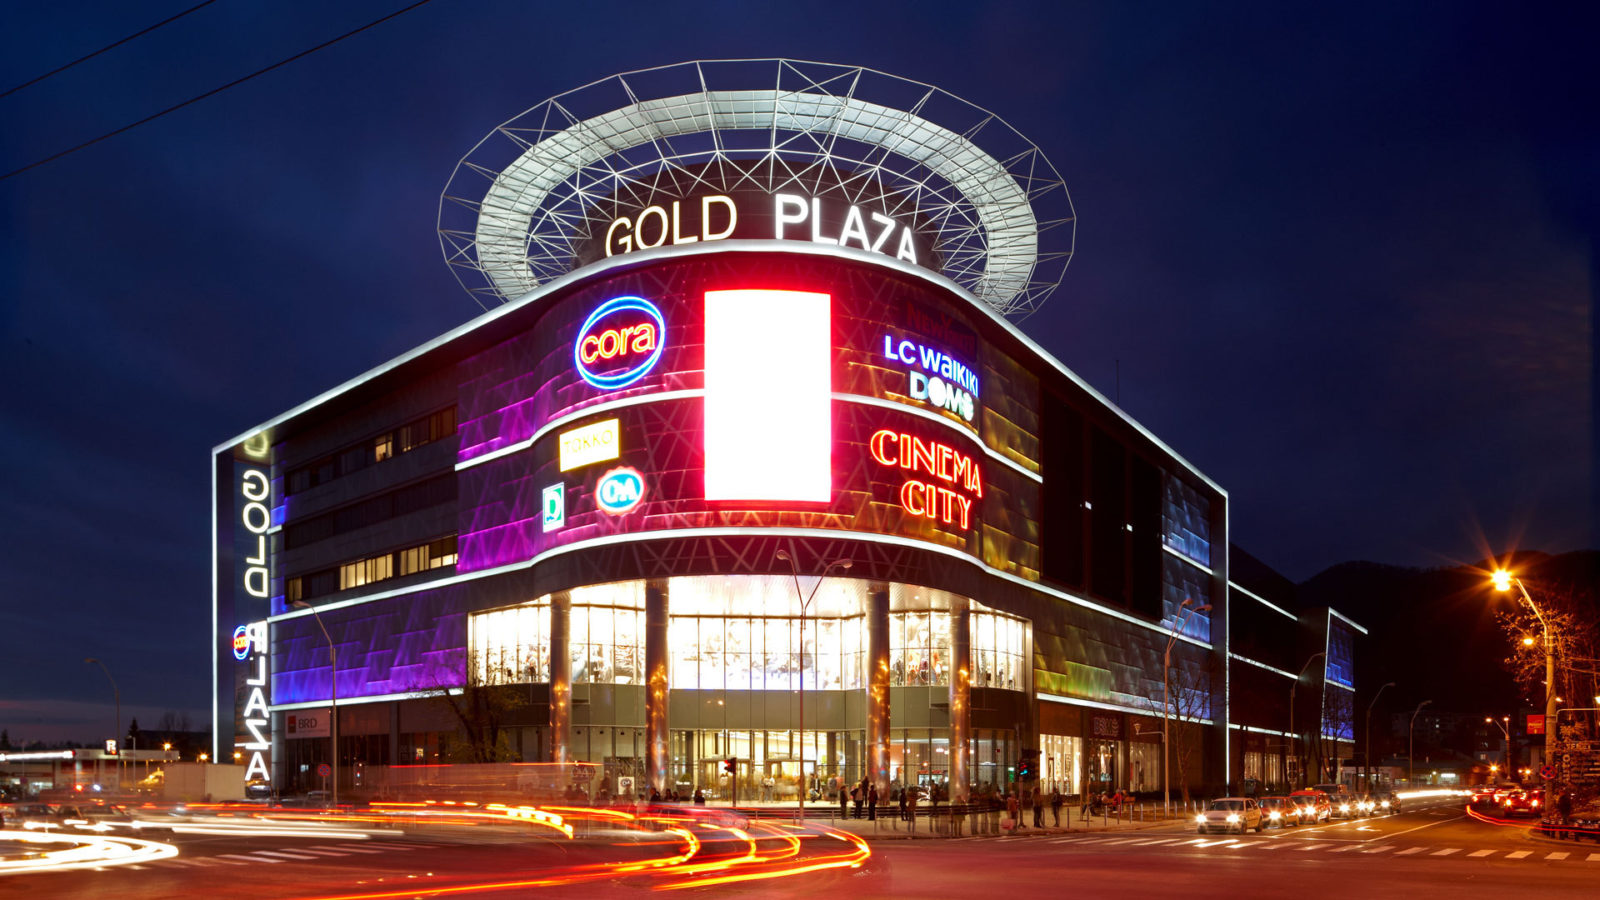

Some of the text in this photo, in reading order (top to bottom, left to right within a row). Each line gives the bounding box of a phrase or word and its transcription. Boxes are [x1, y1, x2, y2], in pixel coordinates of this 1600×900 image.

[605, 193, 917, 264] GOLD PLAZA
[580, 322, 656, 364] cora
[884, 333, 917, 364] LC
[870, 429, 983, 498] CINEMA
[901, 479, 972, 531] CITY
[298, 717, 318, 729] BRD
